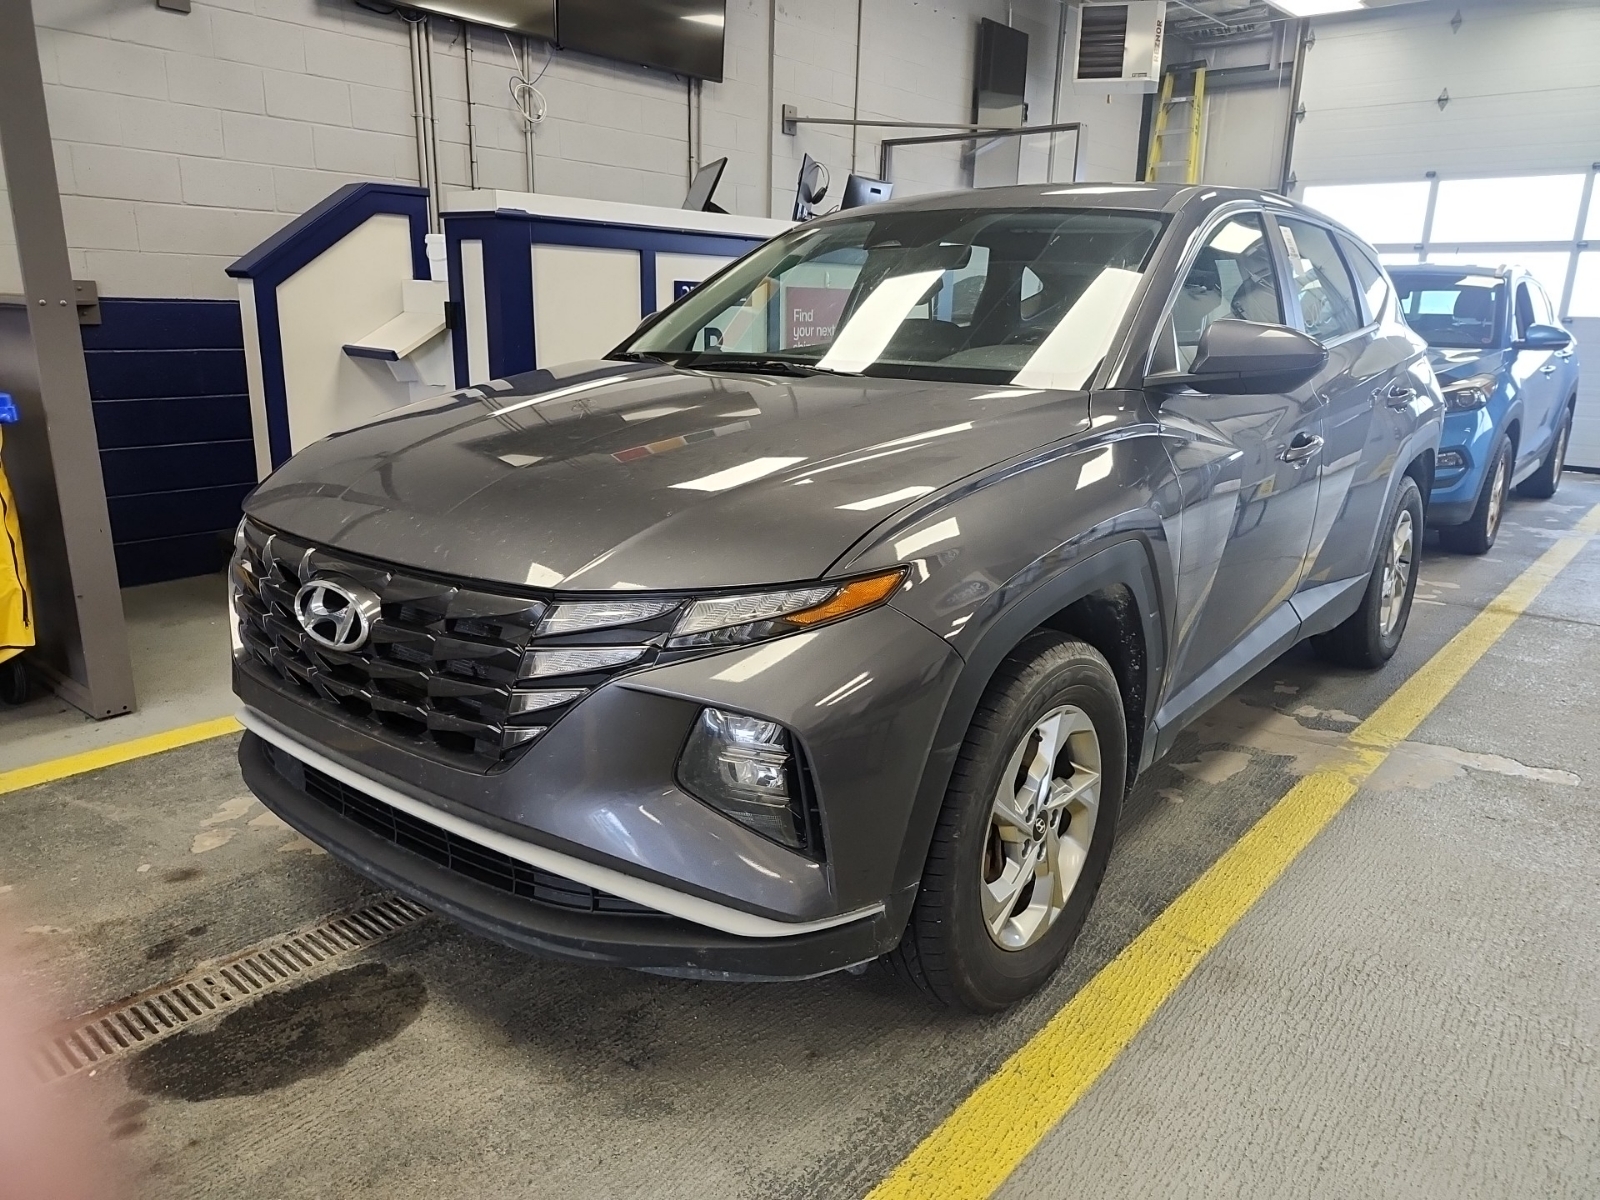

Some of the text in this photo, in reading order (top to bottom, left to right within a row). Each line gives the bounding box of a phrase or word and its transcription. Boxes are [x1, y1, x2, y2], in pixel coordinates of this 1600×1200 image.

[1153, 19, 1163, 63] REZNOR
[793, 308, 814, 322] Find
[793, 324, 836, 341] your next
